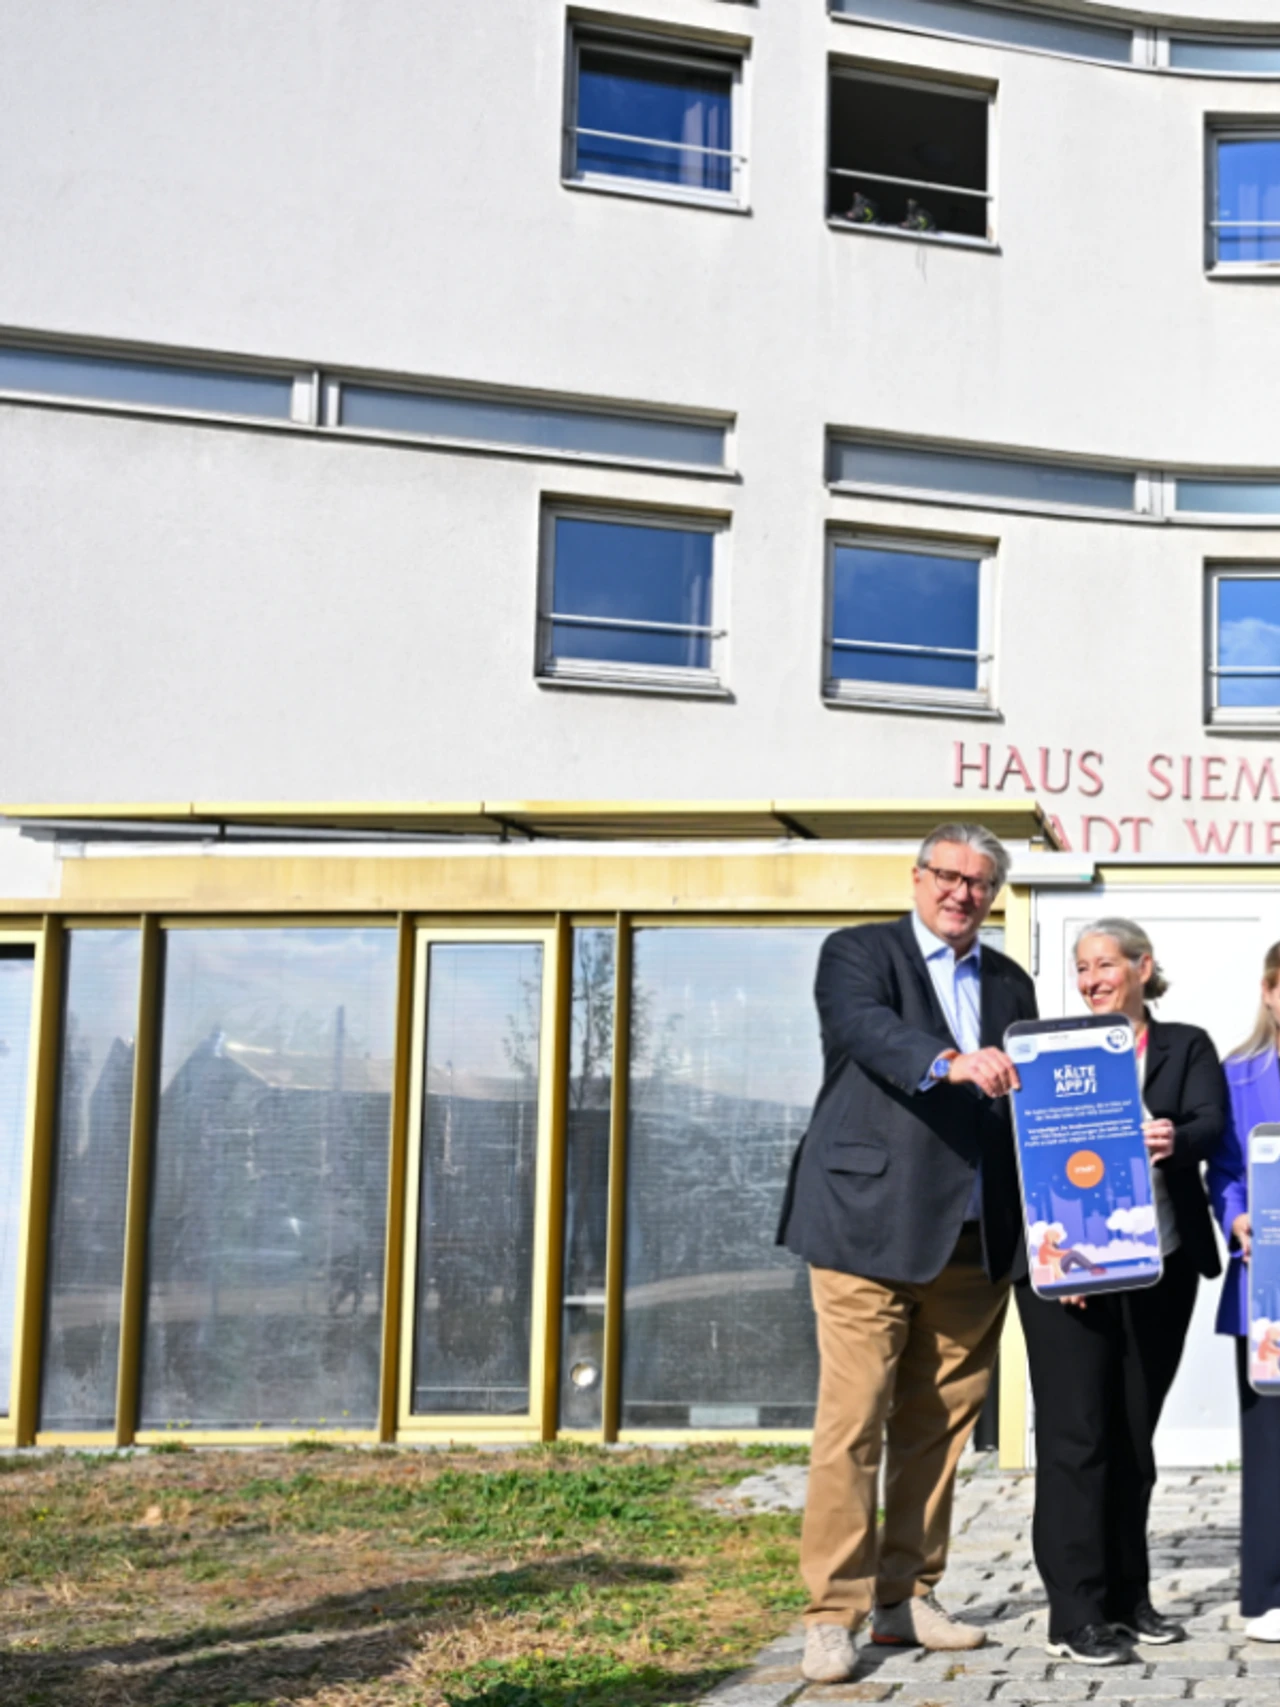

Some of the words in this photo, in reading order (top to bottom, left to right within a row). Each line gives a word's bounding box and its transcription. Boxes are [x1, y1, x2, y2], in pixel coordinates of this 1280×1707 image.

[953, 741, 1104, 797] HAUS
[1048, 813, 1153, 853] ADT
[1054, 1064, 1096, 1080] KÄLTE
